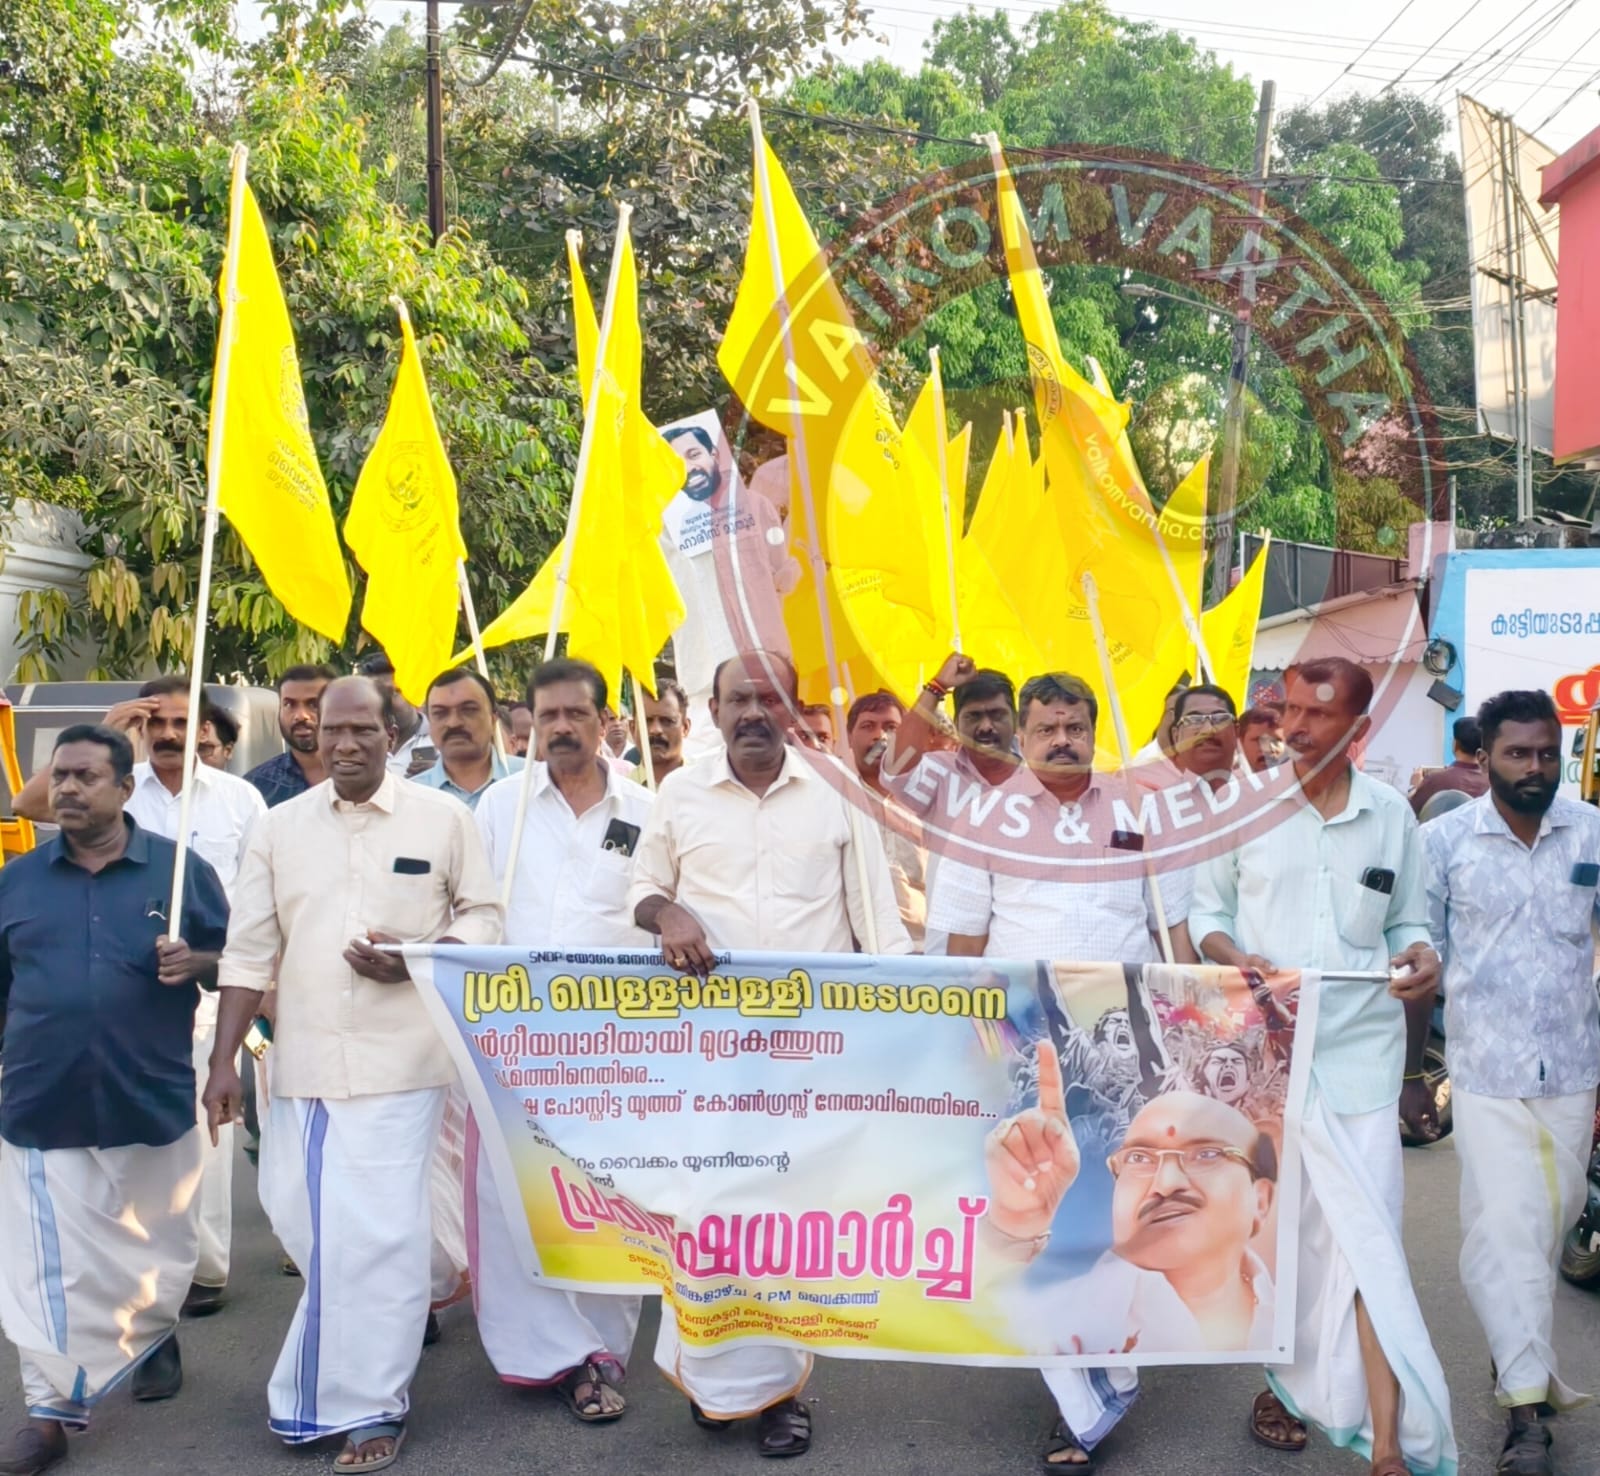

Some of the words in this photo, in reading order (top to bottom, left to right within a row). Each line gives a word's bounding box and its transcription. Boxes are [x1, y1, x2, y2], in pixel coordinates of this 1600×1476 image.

[529, 951, 562, 964] SNDP
[566, 953, 615, 965] യോഗം
[464, 964, 543, 1024] ശ്രീ.
[547, 968, 813, 1019] വെള്ളാപ്പള്ളി
[821, 981, 1008, 1021] നടേശനെ
[474, 1021, 693, 1067] ർഗ്ഗീയവാദിയായി
[699, 1027, 845, 1061] മുദ്രകുത്തുന്ന
[814, 1089, 997, 1119] നേതാവിനെതിരെ...
[600, 1155, 678, 1169] വൈക്കം
[682, 1151, 790, 1173] യൂണിയന്റെ
[753, 1292, 763, 1301] 4
[767, 1290, 791, 1302] PM
